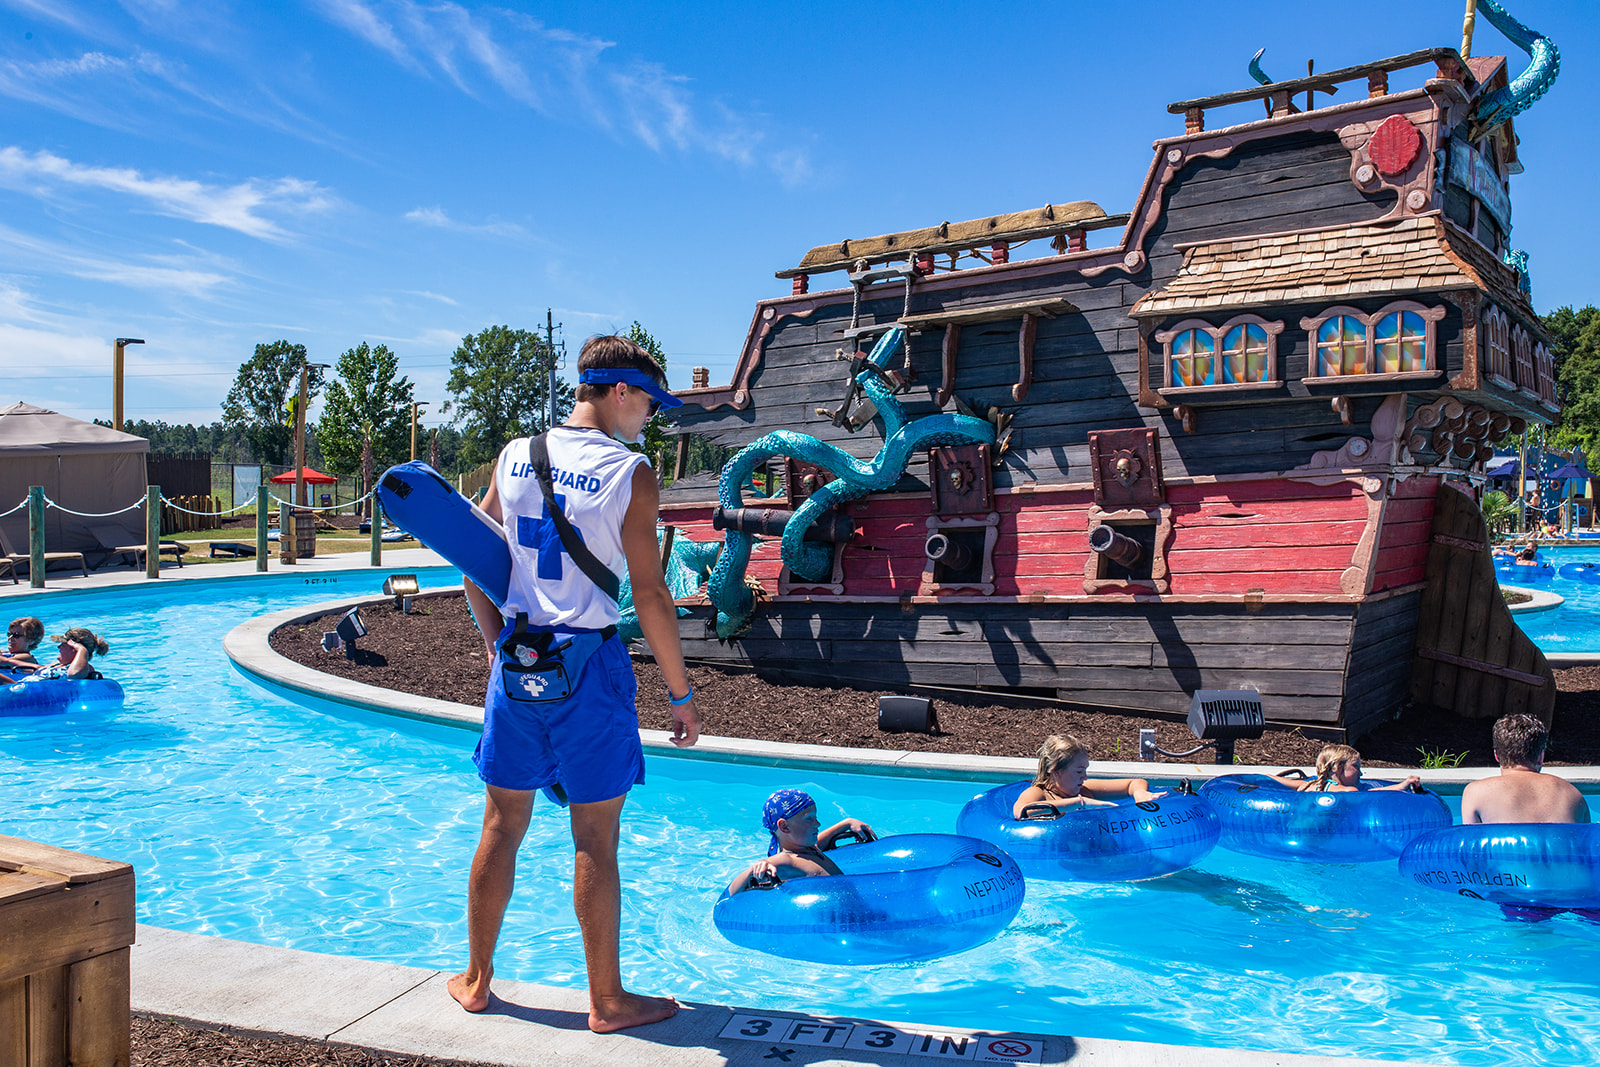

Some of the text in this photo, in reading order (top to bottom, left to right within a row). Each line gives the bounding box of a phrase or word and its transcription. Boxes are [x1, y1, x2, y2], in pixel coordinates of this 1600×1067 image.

[510, 462, 601, 493] LIFGARD
[519, 673, 549, 687] LIFEGUARD
[1098, 806, 1205, 835] NEPTUNE ISLAND
[963, 870, 1015, 900] NEPTUNE
[1451, 870, 1527, 887] NEPTUNE
[740, 1019, 969, 1056] 3 FT 3 IN
